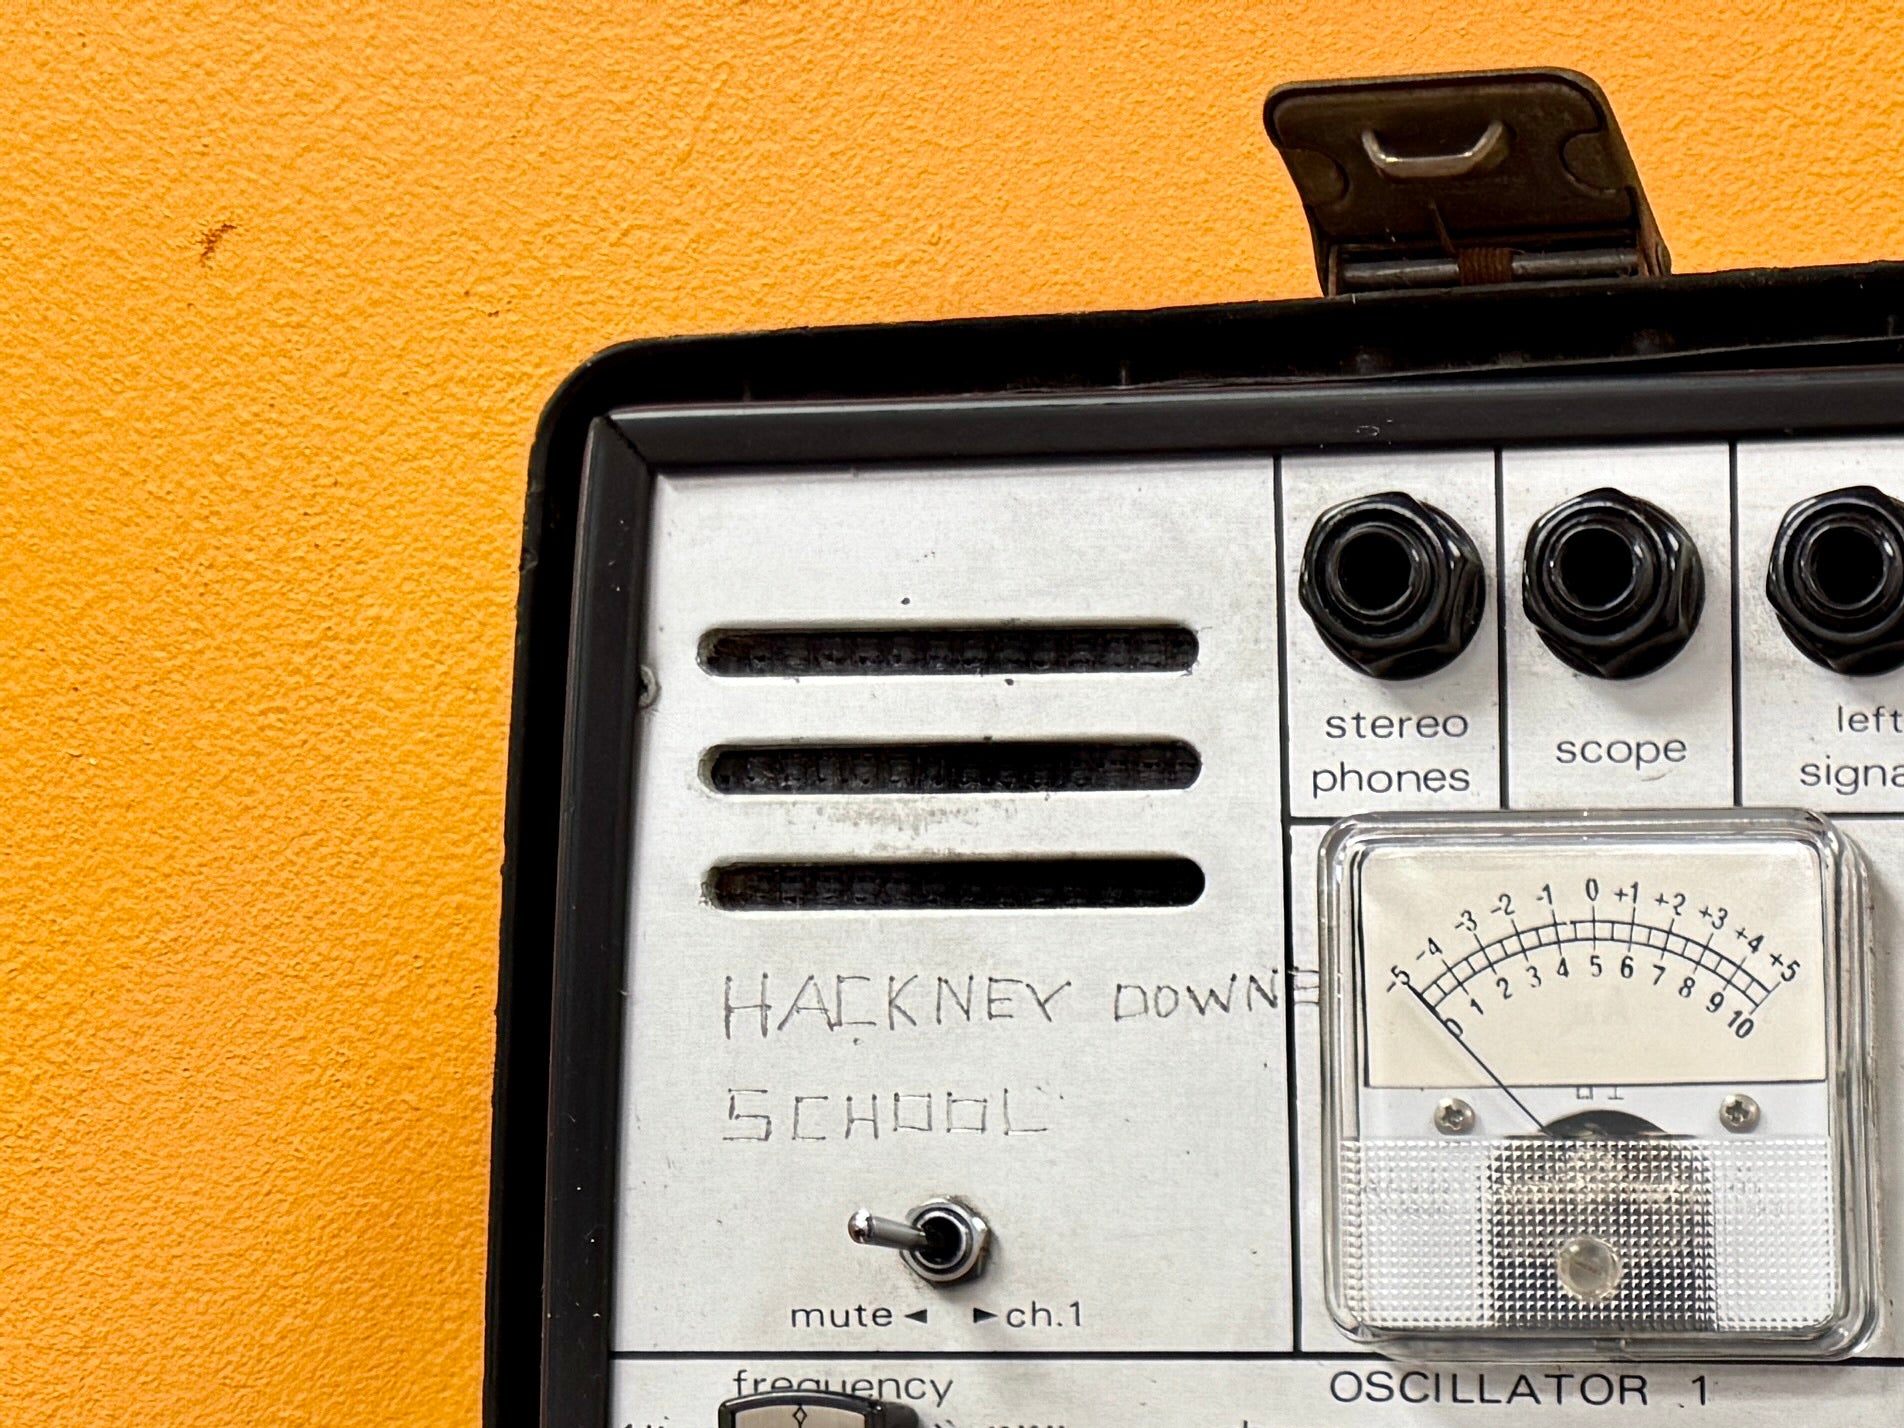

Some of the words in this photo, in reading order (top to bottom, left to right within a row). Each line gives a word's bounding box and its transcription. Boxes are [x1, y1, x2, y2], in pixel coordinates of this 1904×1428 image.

[1325, 710, 1468, 740] stereo
[1837, 703, 1904, 734] left
[1556, 738, 1687, 771] scope
[1312, 760, 1470, 800] phones
[723, 972, 1072, 1040] HACKNEY
[1112, 965, 1320, 1022] DOWN
[1652, 963, 1667, 986] 7
[1677, 975, 1696, 999] 8
[1727, 1009, 1755, 1039] 10
[722, 1086, 1048, 1142] SCHOOL
[791, 1303, 893, 1329] mute
[1005, 1300, 1081, 1329] ch.1
[1329, 1370, 1650, 1409] OSCILLATOR
[1691, 1375, 1709, 1407] 1
